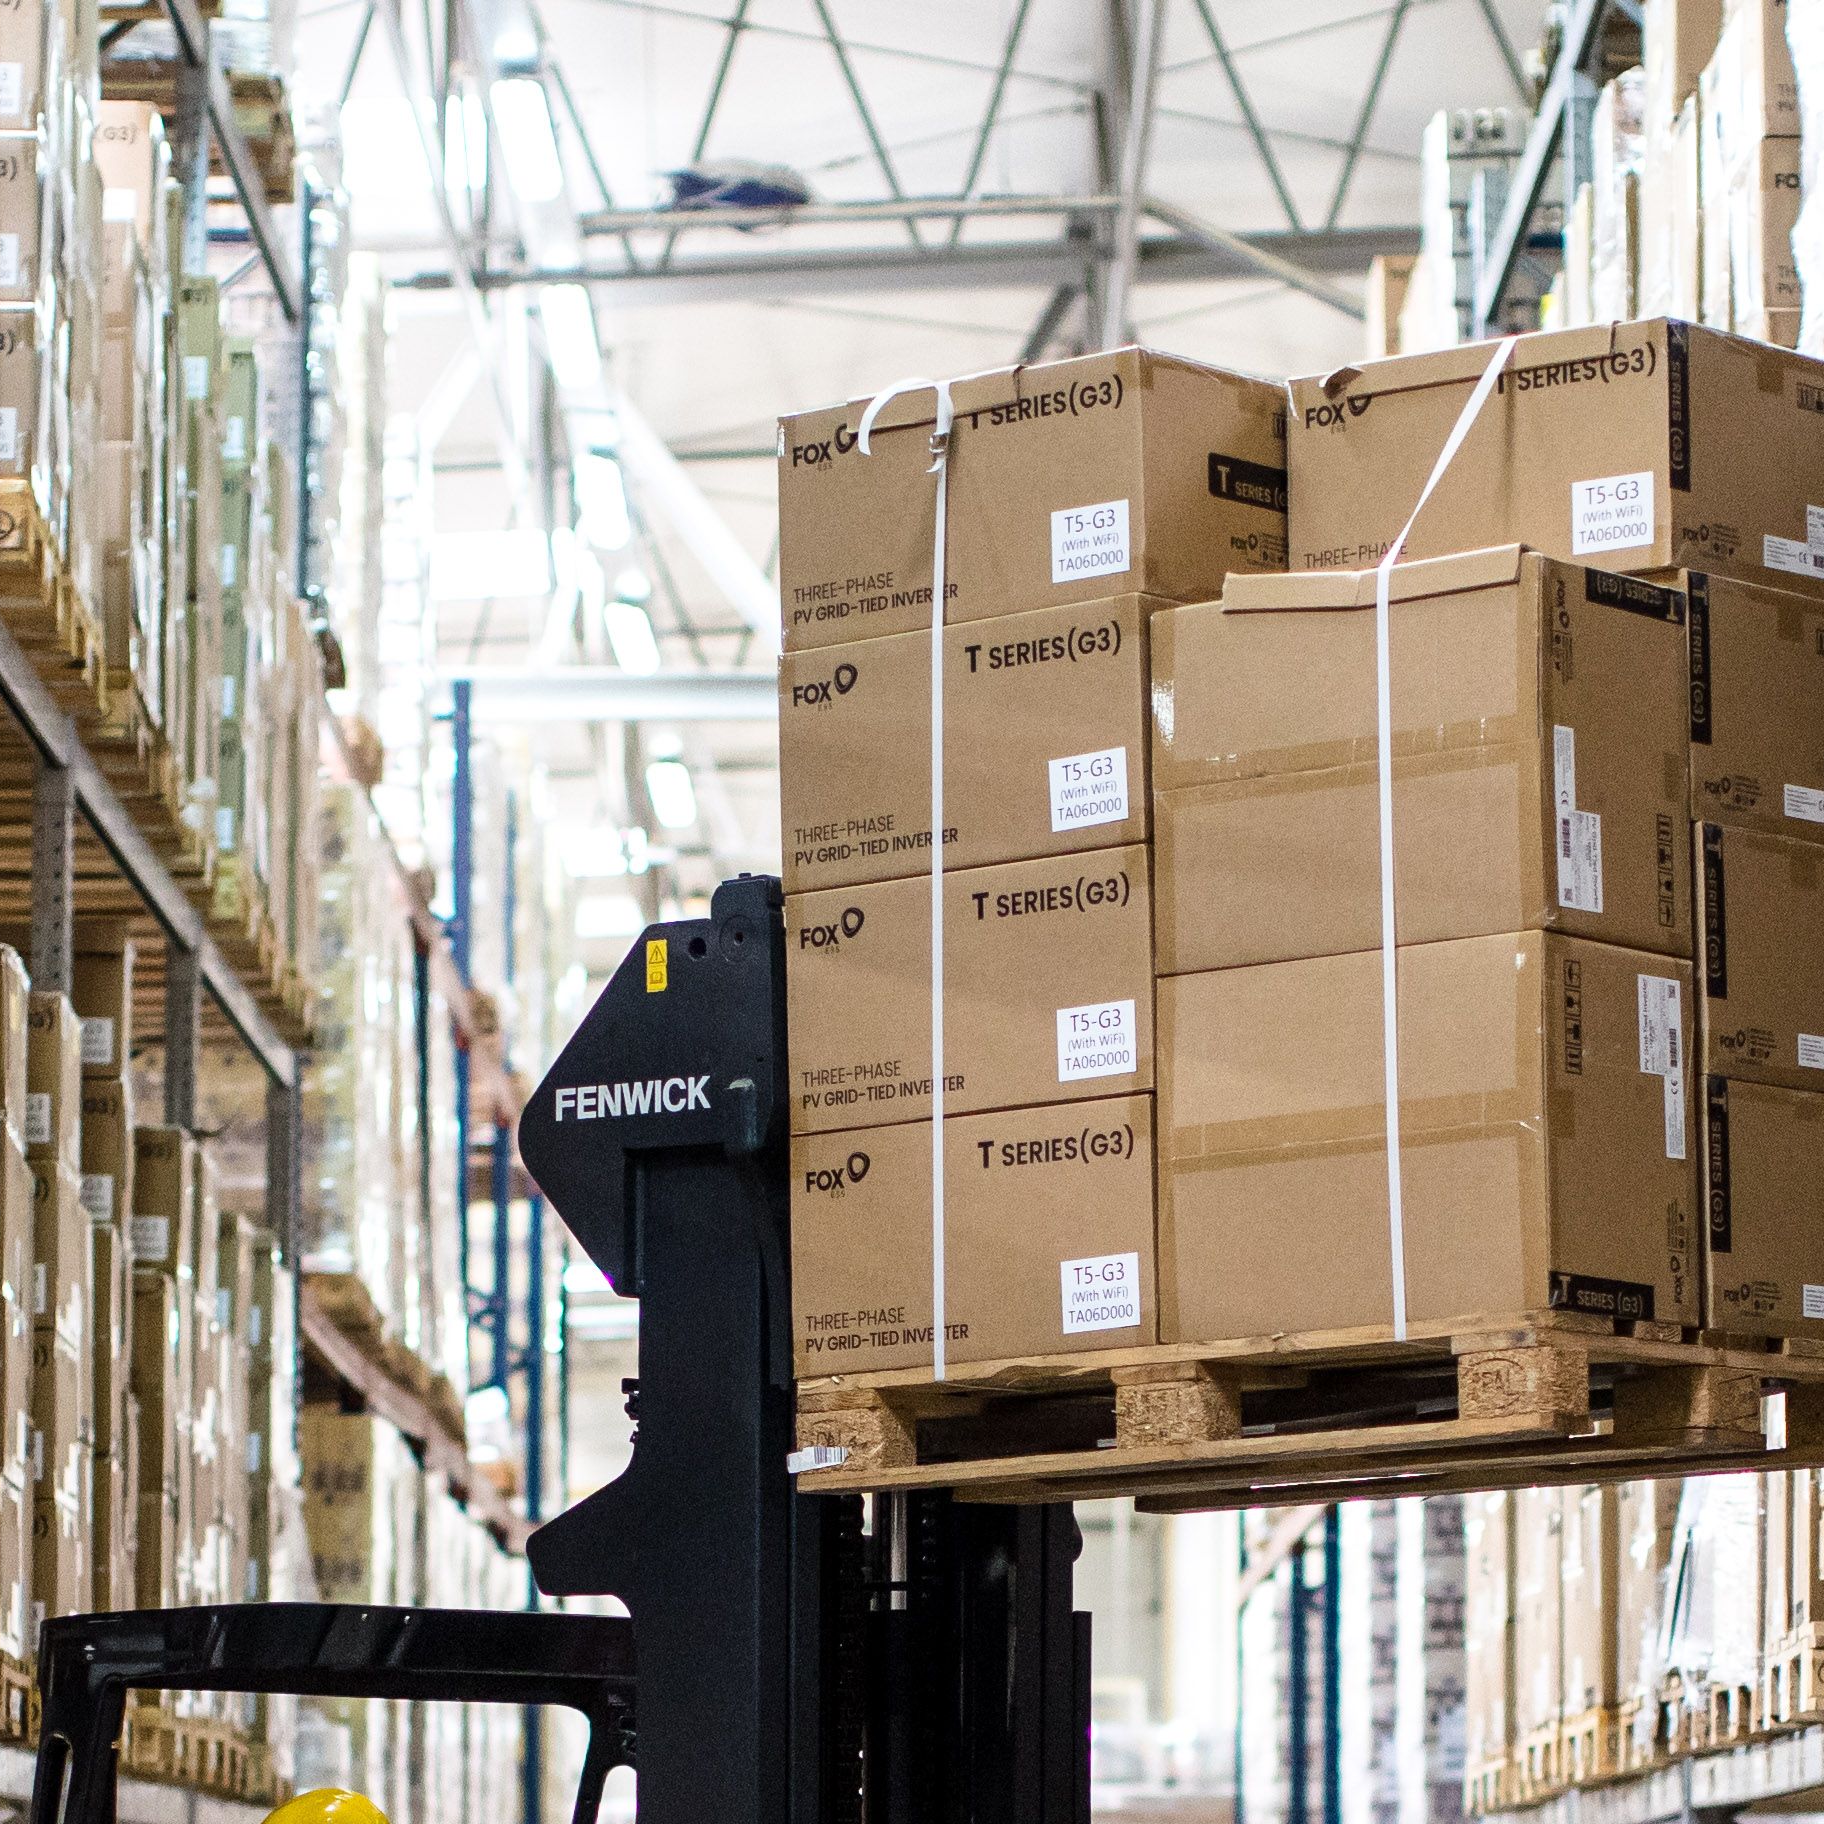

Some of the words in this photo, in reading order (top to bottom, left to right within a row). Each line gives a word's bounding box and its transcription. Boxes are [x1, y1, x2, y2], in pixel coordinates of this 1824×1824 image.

[1517, 342, 1657, 393] SERIES(G3)
[991, 374, 1123, 425] SERIES(G3)
[1306, 403, 1346, 428] FOX
[793, 442, 832, 467] FOX
[1217, 465, 1230, 492] T
[1235, 480, 1271, 502] SERIES
[1585, 481, 1640, 505] T5-G3
[1064, 510, 1116, 533] T5-G3
[1582, 509, 1611, 526] (With
[1613, 505, 1643, 522] WiFi)
[1062, 534, 1090, 553] (With
[1093, 532, 1120, 548] WiFi)
[1578, 522, 1648, 545] TA06D000
[1058, 550, 1124, 573] TA06D000
[794, 572, 894, 603] THREE-PHASE
[794, 610, 812, 625] PV
[816, 597, 888, 621] GRID-TIED
[892, 584, 958, 608] INVERER
[965, 645, 982, 674] T
[989, 621, 1121, 670] SERIES(G3)
[1693, 613, 1705, 674] SERIES
[793, 681, 832, 707] FOX
[1692, 681, 1706, 724] (G3)
[1062, 758, 1114, 782] T5-G3
[1060, 783, 1089, 803] (With
[1091, 780, 1117, 796] WiFi)
[1057, 798, 1122, 822] TA06D000
[794, 815, 895, 845] THREE-PHASE
[795, 849, 813, 868] PV
[816, 839, 890, 865] GRID-TIED
[891, 828, 959, 854] INVERER
[973, 892, 989, 920] T
[996, 872, 1130, 917] SERIES(G3)
[1707, 867, 1718, 930] SERIES
[800, 924, 839, 949] FOX
[1070, 1008, 1122, 1033] T5-G3
[1068, 1035, 1096, 1053] (With
[1099, 1032, 1125, 1048] WiFi)
[802, 1061, 901, 1088] THREE-PHASE
[1064, 1050, 1130, 1073] TA06D000
[556, 1075, 711, 1121] FENWICK
[802, 1092, 820, 1110] PV
[824, 1083, 897, 1107] GRID-TIED
[899, 1076, 965, 1100] INVETER
[978, 1141, 994, 1169] T
[1001, 1125, 1134, 1167] SERIES(G3)
[1711, 1121, 1721, 1184] SERIES
[806, 1168, 845, 1193] FOX
[1074, 1262, 1125, 1286] T5-G3
[1071, 1289, 1099, 1306] (With
[1102, 1286, 1129, 1301] WiFi)
[1558, 1276, 1572, 1302] T
[1577, 1290, 1614, 1310] SERIES
[1618, 1291, 1643, 1316] (G3)
[806, 1307, 905, 1333] THREE-PHASE
[1068, 1303, 1133, 1326] TA06D000
[806, 1337, 824, 1354] PV
[827, 1329, 899, 1352] GRID-TIED
[902, 1323, 969, 1347] INVETER
